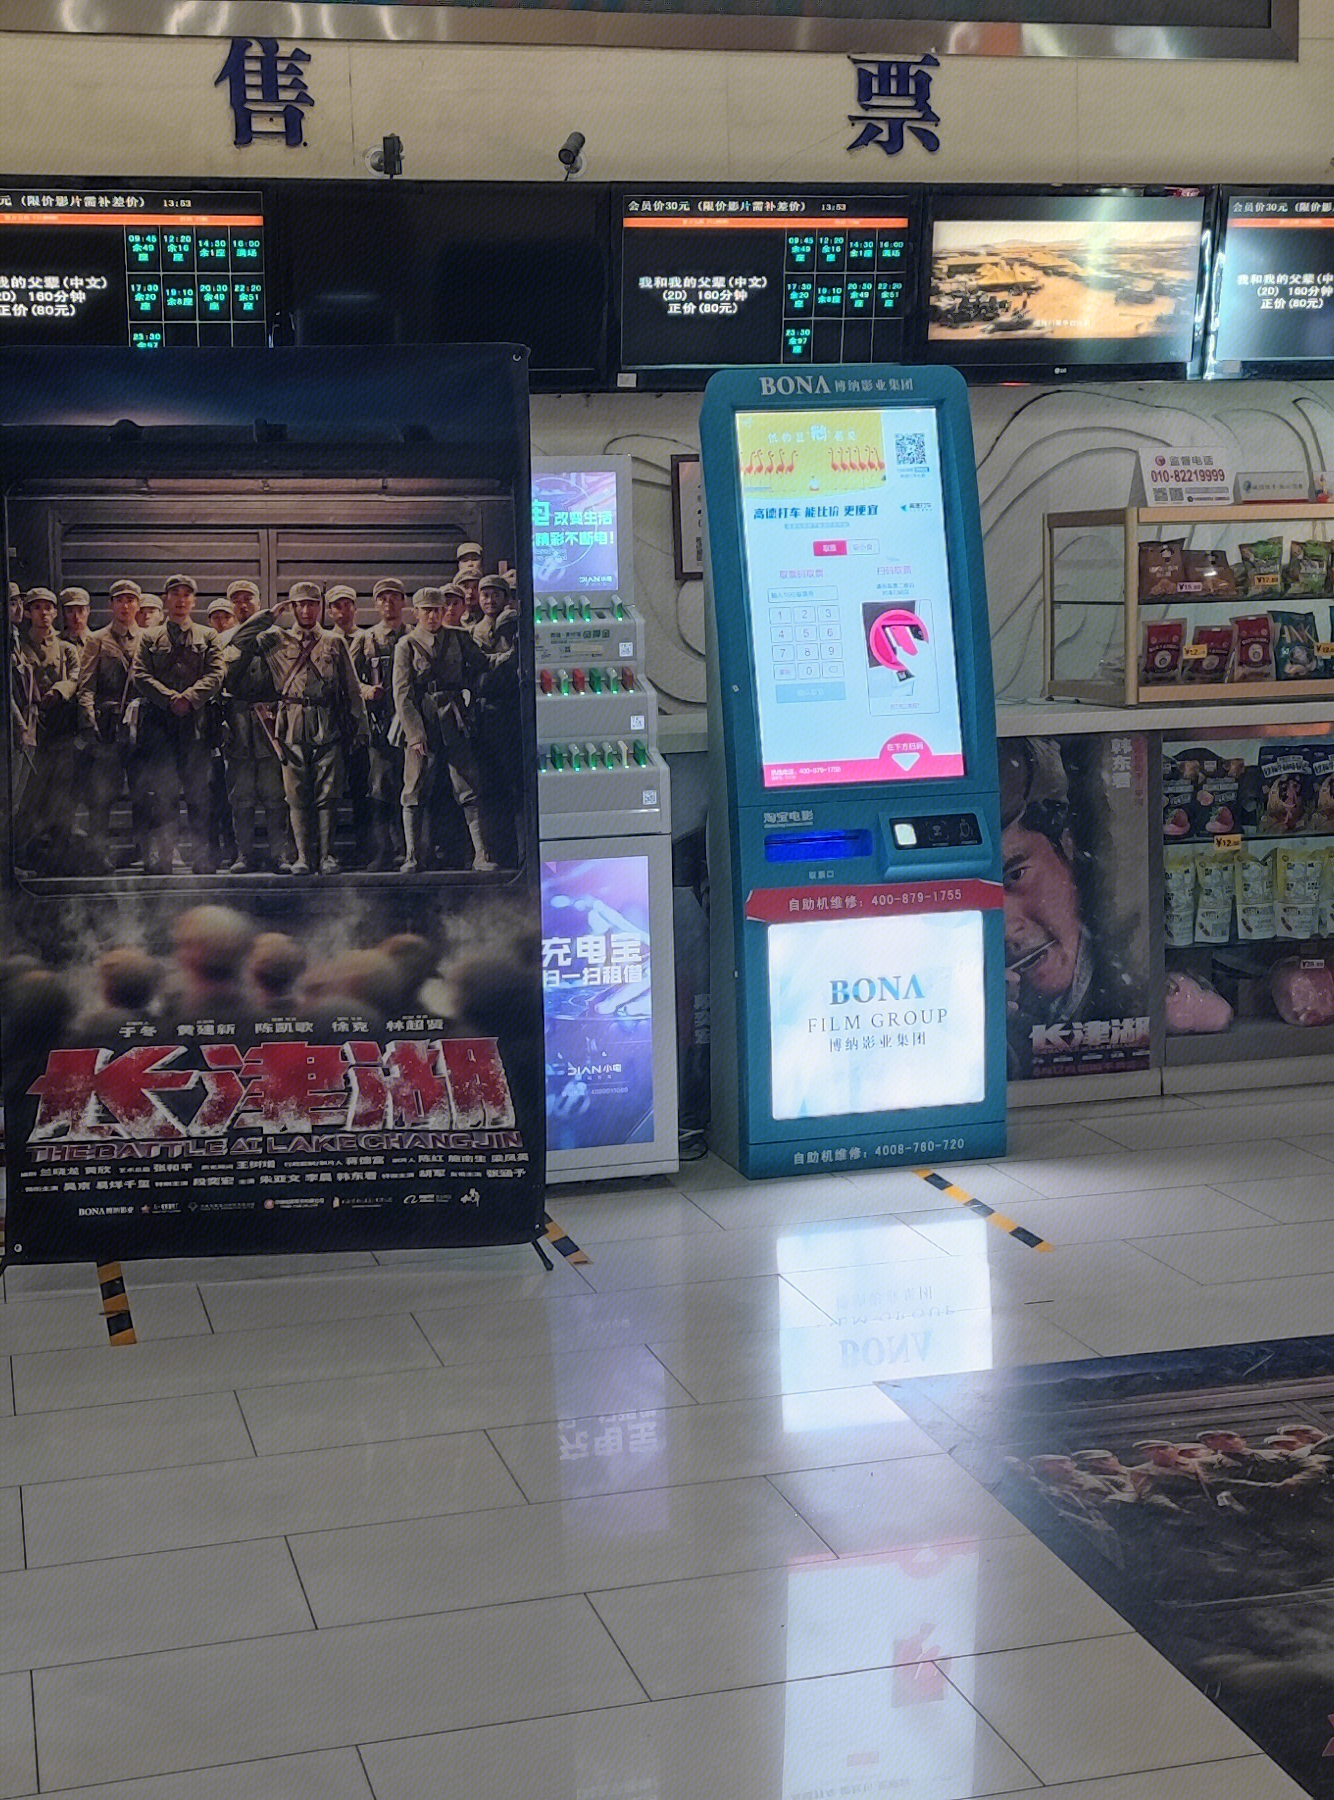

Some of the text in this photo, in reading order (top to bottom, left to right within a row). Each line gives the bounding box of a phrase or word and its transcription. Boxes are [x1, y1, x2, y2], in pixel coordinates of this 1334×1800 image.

[214, 37, 941, 155] 售 票
[628, 201, 690, 211] 会员价30元
[1233, 201, 1288, 213] 会员价30元
[129, 235, 157, 243] 09:45
[164, 235, 192, 243] 12:20
[131, 284, 158, 292] 17:30
[200, 284, 228, 292] 20:30
[234, 284, 262, 292] 22:20
[697, 290, 748, 301] 160分钟
[1288, 285, 1334, 298] 160分钟
[29, 290, 86, 302] 160分钟
[760, 376, 913, 395] BONA 博纳影业集团
[1170, 455, 1214, 466] 监督电话
[1151, 468, 1225, 483] 010-82219999
[554, 511, 612, 525] 改变生活
[753, 504, 878, 519] 高德打车 能比价 更便宜
[763, 810, 814, 824] 淘宝电影
[871, 889, 962, 906] 400-879-1755
[541, 933, 642, 967] 充电宝
[829, 974, 925, 1005] BONA
[119, 1018, 444, 1038] 于冬 黄建新 陈凯歌 徐克 林超贤
[808, 1008, 948, 1033] FILM GROUP
[830, 1032, 926, 1052] 博纳影业集团
[26, 1037, 516, 1142] 长津湖
[28, 1144, 99, 1163] THE
[100, 1139, 228, 1160] BATTLE
[268, 1135, 359, 1154] LAKE
[360, 1130, 523, 1151] CHANGJIN
